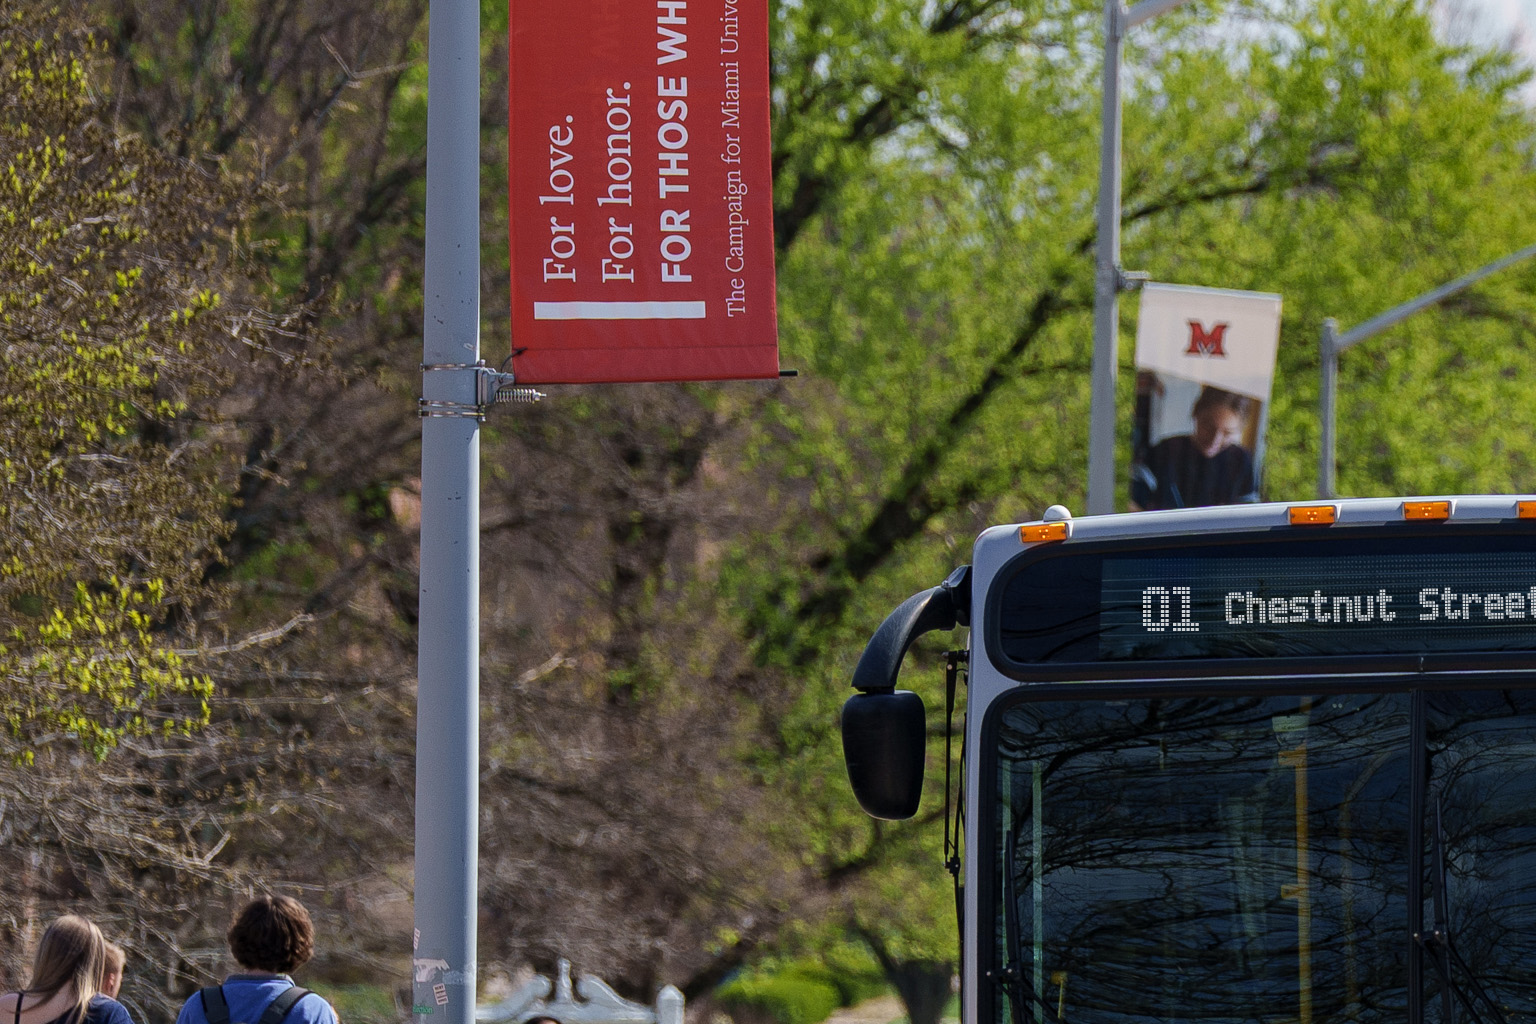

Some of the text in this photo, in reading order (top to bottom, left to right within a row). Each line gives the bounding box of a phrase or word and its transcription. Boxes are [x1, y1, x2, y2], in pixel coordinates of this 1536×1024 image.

[720, 61, 741, 130] Miami
[658, 75, 689, 199] THOSE
[720, 133, 742, 166] for
[539, 113, 576, 283] For love.
[597, 81, 635, 284] For honor.
[660, 209, 693, 283] FOR
[723, 169, 749, 274] Campaign
[726, 277, 747, 317] The
[1184, 317, 1229, 357] M
[1141, 586, 1200, 632] 01
[1223, 588, 1397, 625] Chestnut
